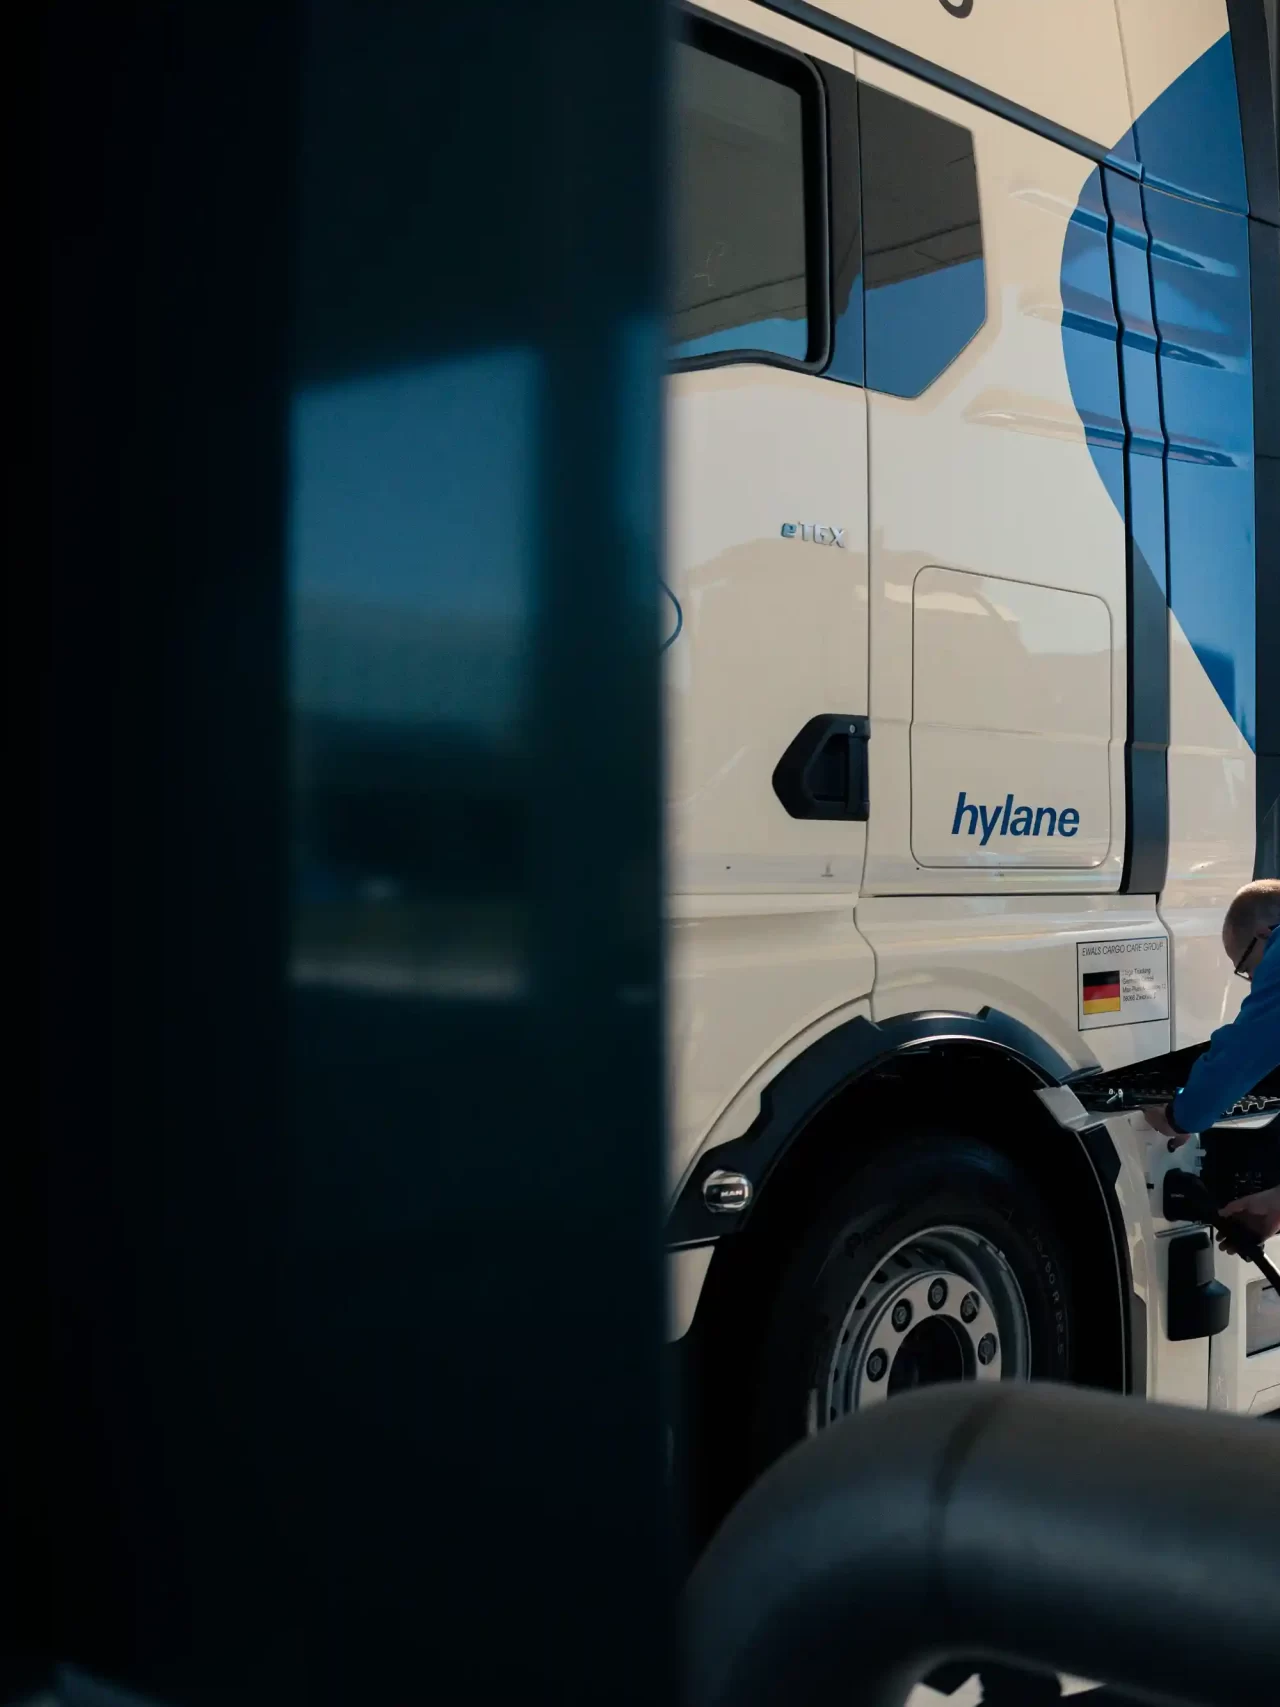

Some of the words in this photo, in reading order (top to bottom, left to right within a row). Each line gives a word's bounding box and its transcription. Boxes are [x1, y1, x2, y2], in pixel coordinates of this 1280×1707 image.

[951, 792, 1080, 846] hylane
[1082, 947, 1102, 956] EWALS
[1102, 945, 1125, 955] CARGO
[1126, 943, 1142, 953] CARE
[1143, 941, 1164, 951] GROUP
